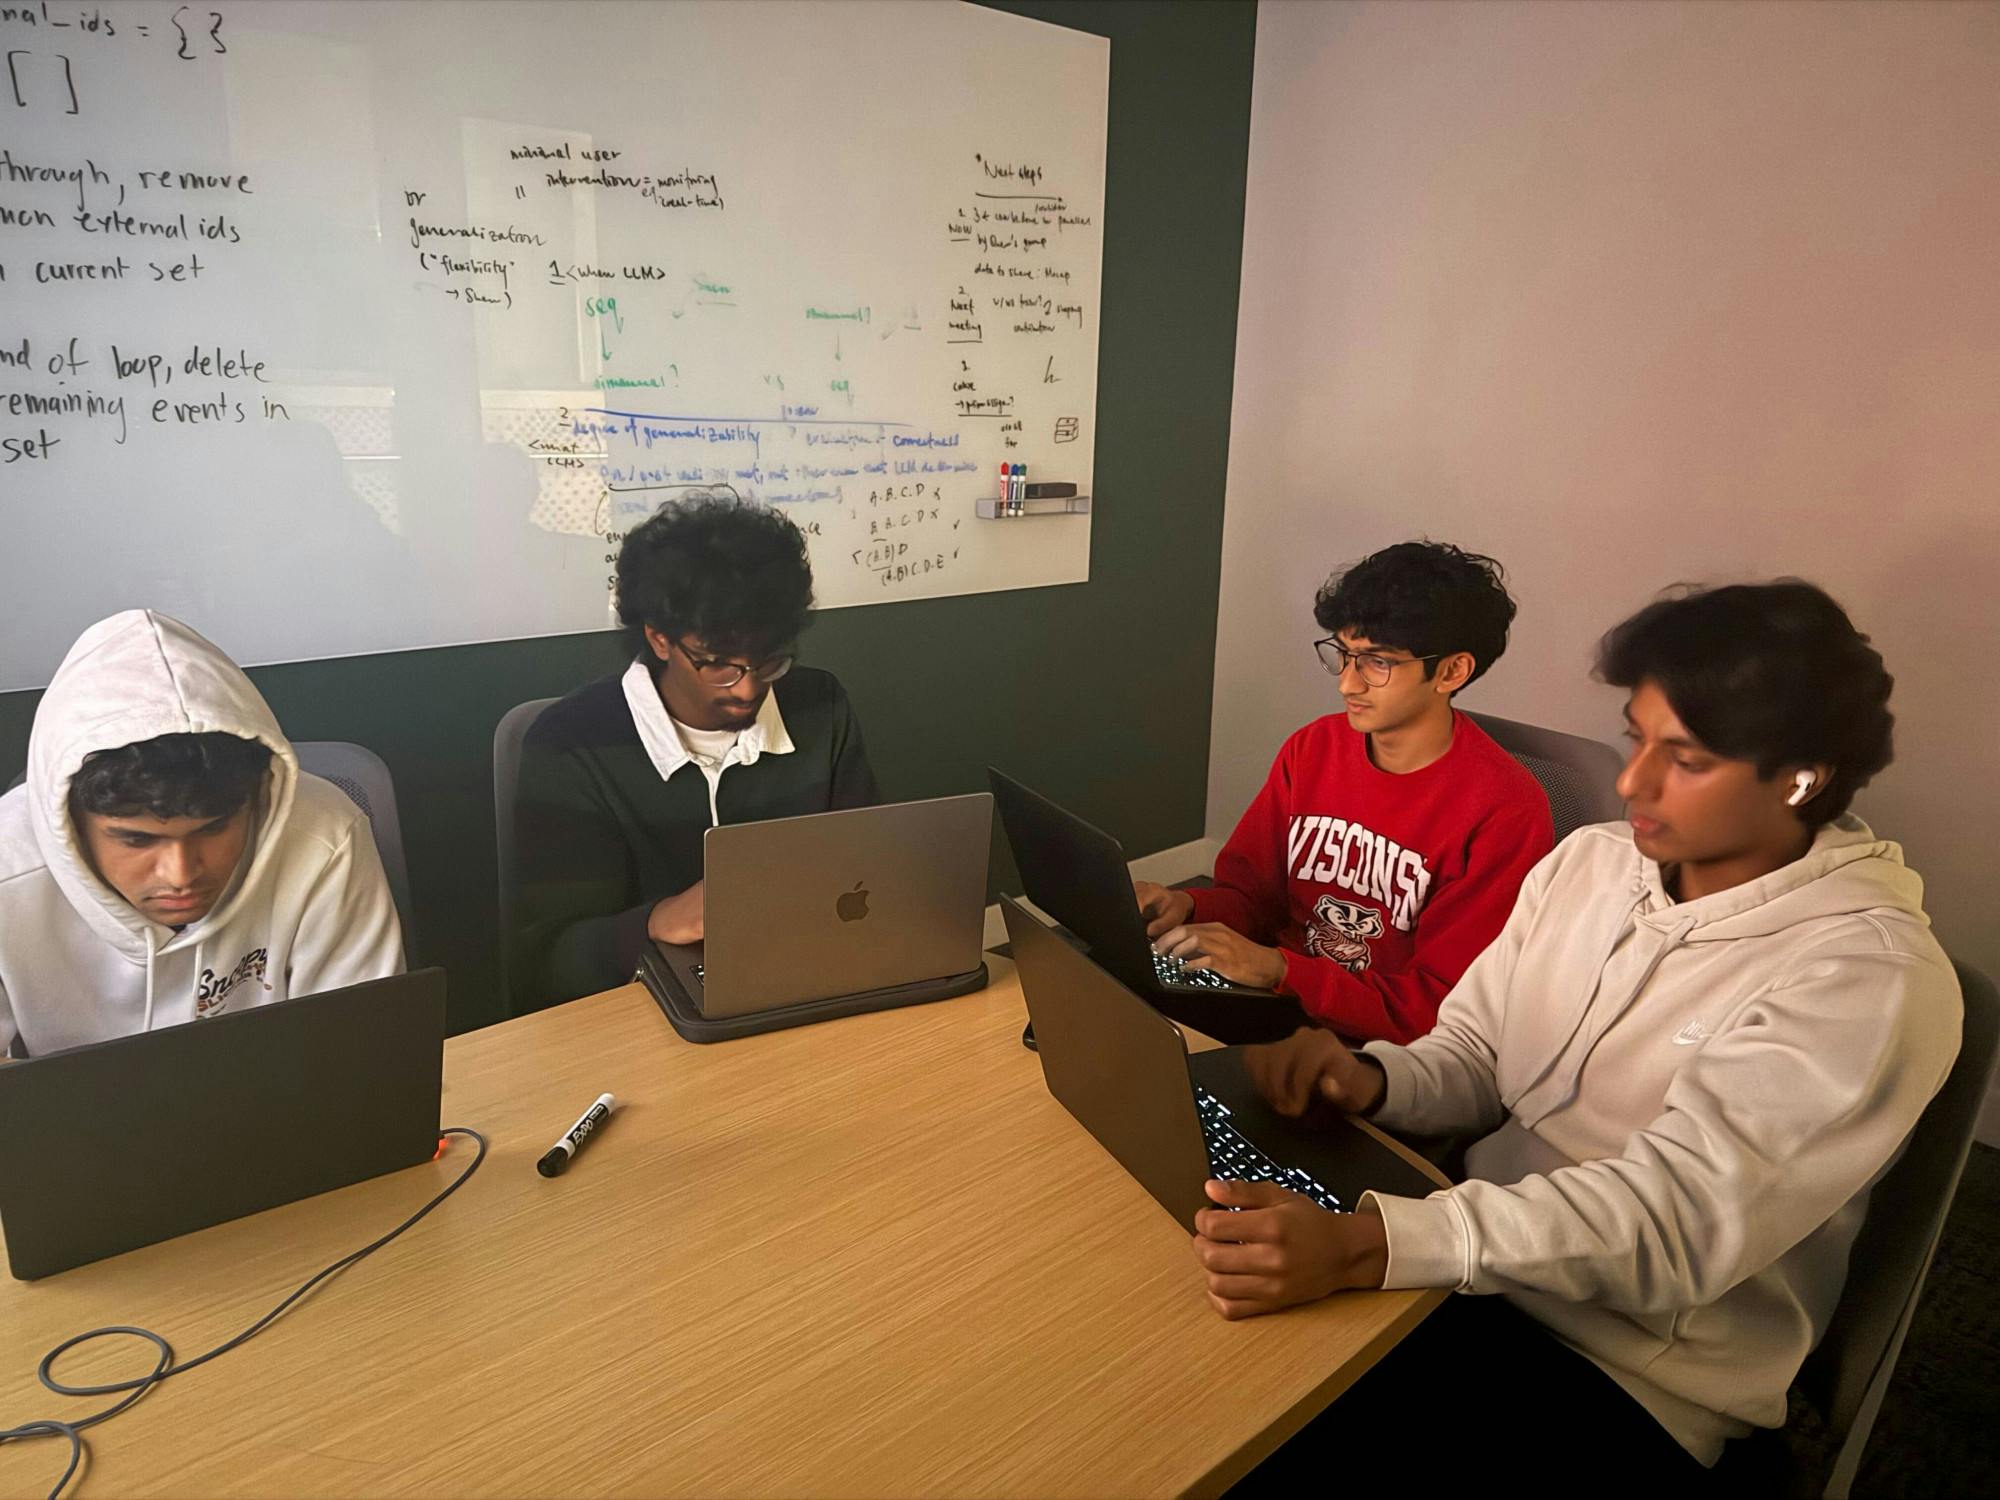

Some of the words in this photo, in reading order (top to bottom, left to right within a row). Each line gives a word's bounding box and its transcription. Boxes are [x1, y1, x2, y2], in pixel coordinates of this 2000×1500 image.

[581, 151, 622, 161] user
[139, 170, 253, 195] remove
[73, 208, 188, 241] external
[199, 214, 241, 243] ids
[409, 217, 547, 249] generalization
[36, 255, 130, 284] current
[149, 253, 206, 283] set
[48, 338, 89, 376] of
[184, 345, 274, 383] delete
[0, 381, 126, 445] emaining
[152, 391, 246, 424] events
[262, 395, 291, 420] in
[2, 429, 62, 463] set
[1288, 815, 1432, 932] ISCONSN
[572, 1118, 594, 1147] EXPO
